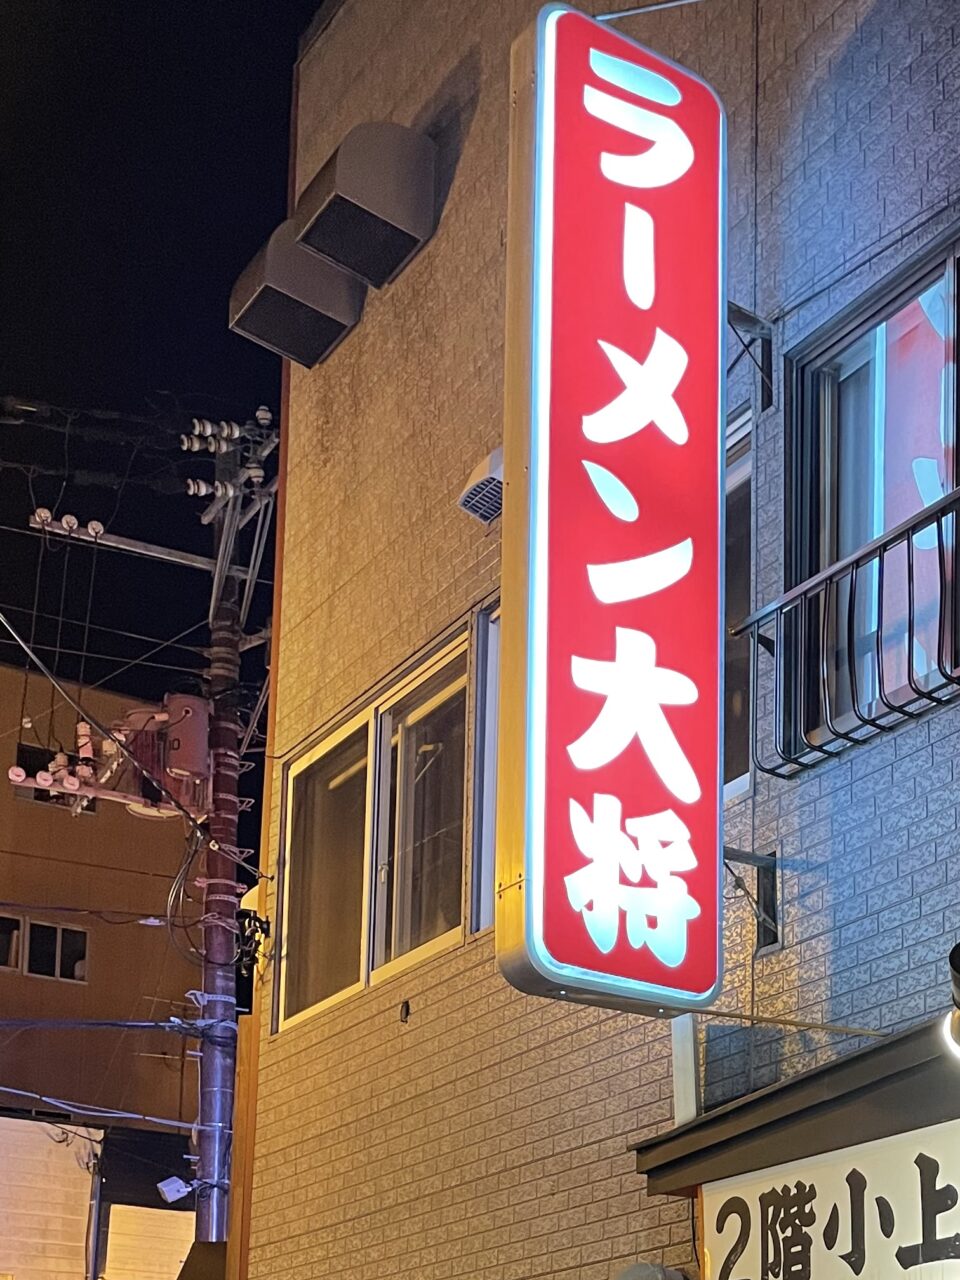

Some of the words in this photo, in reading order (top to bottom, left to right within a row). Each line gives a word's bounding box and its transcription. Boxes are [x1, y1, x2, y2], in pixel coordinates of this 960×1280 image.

[563, 47, 701, 969] ラーメン大将
